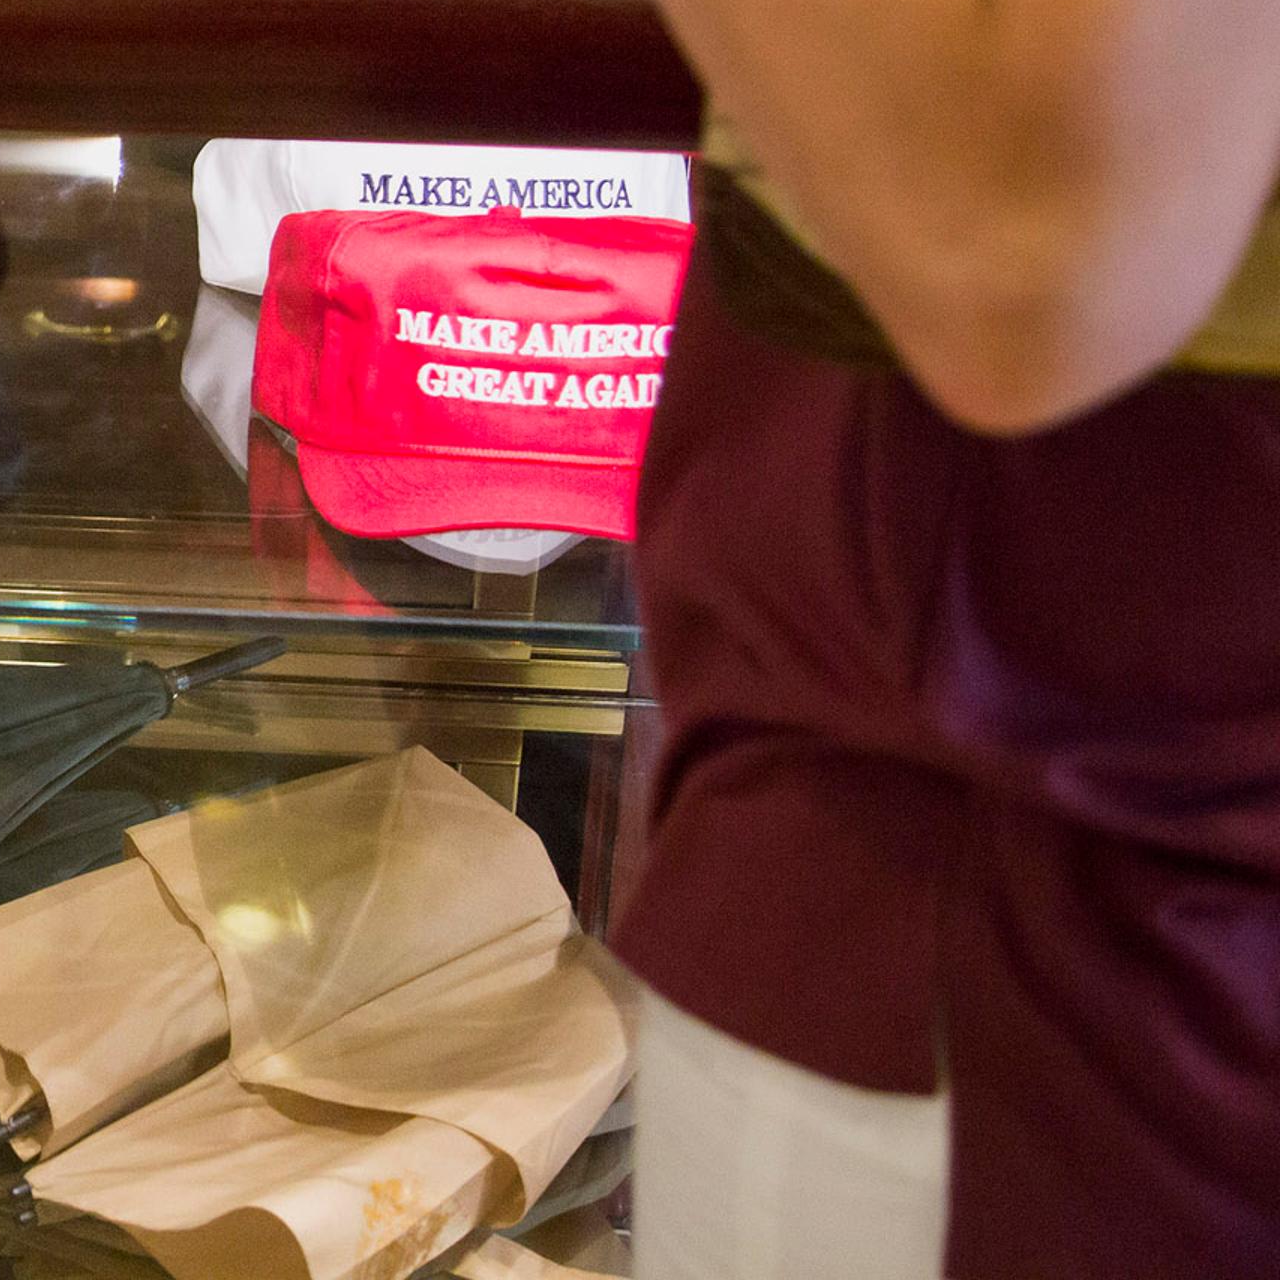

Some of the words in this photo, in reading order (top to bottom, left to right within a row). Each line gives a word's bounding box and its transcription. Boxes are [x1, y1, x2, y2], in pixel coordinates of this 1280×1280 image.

[359, 173, 472, 208] MAKE
[479, 176, 633, 209] AMERICA
[395, 308, 518, 357] MAKE
[519, 324, 674, 358] AMERIC
[415, 362, 555, 407] GREAT
